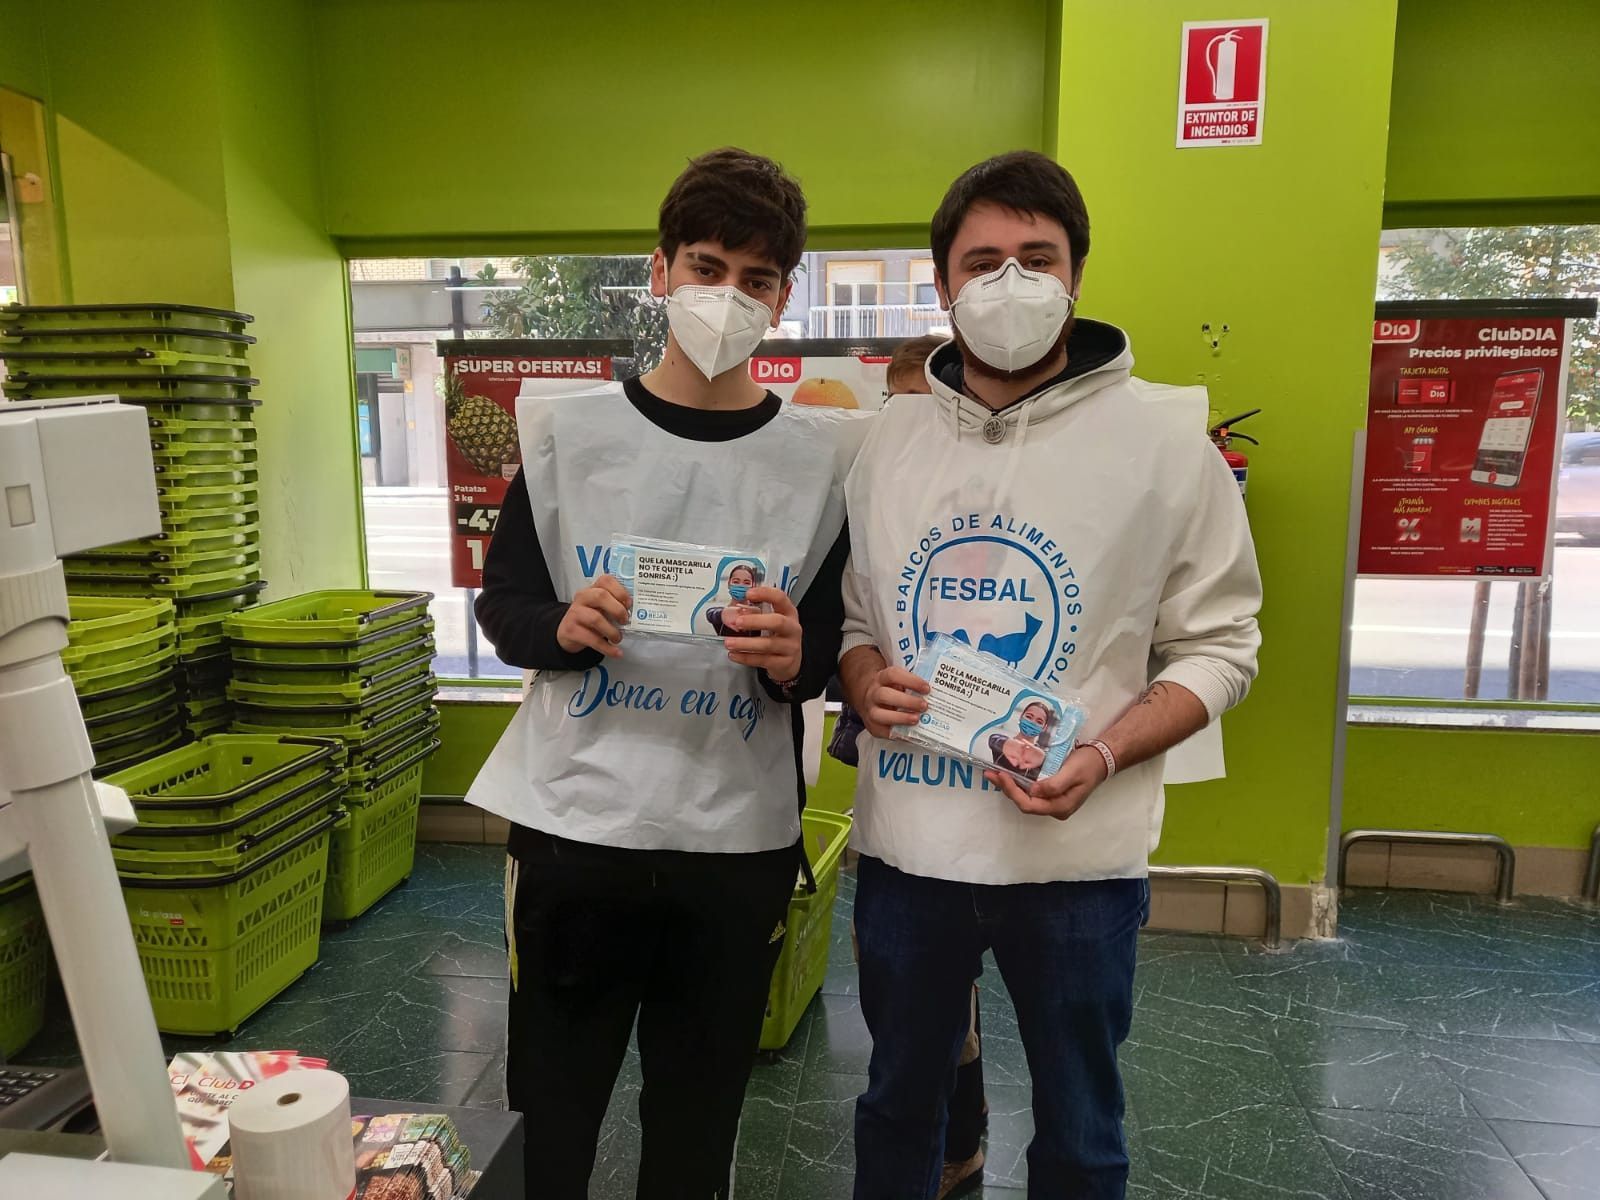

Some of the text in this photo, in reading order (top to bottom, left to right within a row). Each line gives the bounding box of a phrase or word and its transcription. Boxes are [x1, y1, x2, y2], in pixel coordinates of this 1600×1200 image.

[1185, 109, 1255, 124] EXTINTOR DE
[1190, 123, 1249, 137] INCENDIOS
[1478, 327, 1557, 342] ClubDIA
[1409, 346, 1558, 360] Precios privilegiados
[453, 360, 602, 375] ¡SUPER OFERTAS!
[454, 485, 487, 493] Patatas
[454, 494, 474, 504] 3 kg
[638, 556, 654, 564] QUE
[666, 559, 712, 569] MASCARILLA
[661, 565, 684, 574] QUITE
[896, 513, 1083, 616] BANCOS DE ALIMENTOS
[638, 571, 671, 580] SONRISA
[929, 577, 1036, 603] FESBAL
[934, 677, 966, 695] SONRISA
[937, 670, 990, 696] NO TE QUITE LA
[940, 663, 1011, 696] QUE LA MASCARILLA
[567, 664, 671, 718] Dona
[680, 688, 720, 716] en
[198, 1077, 236, 1089] Club
